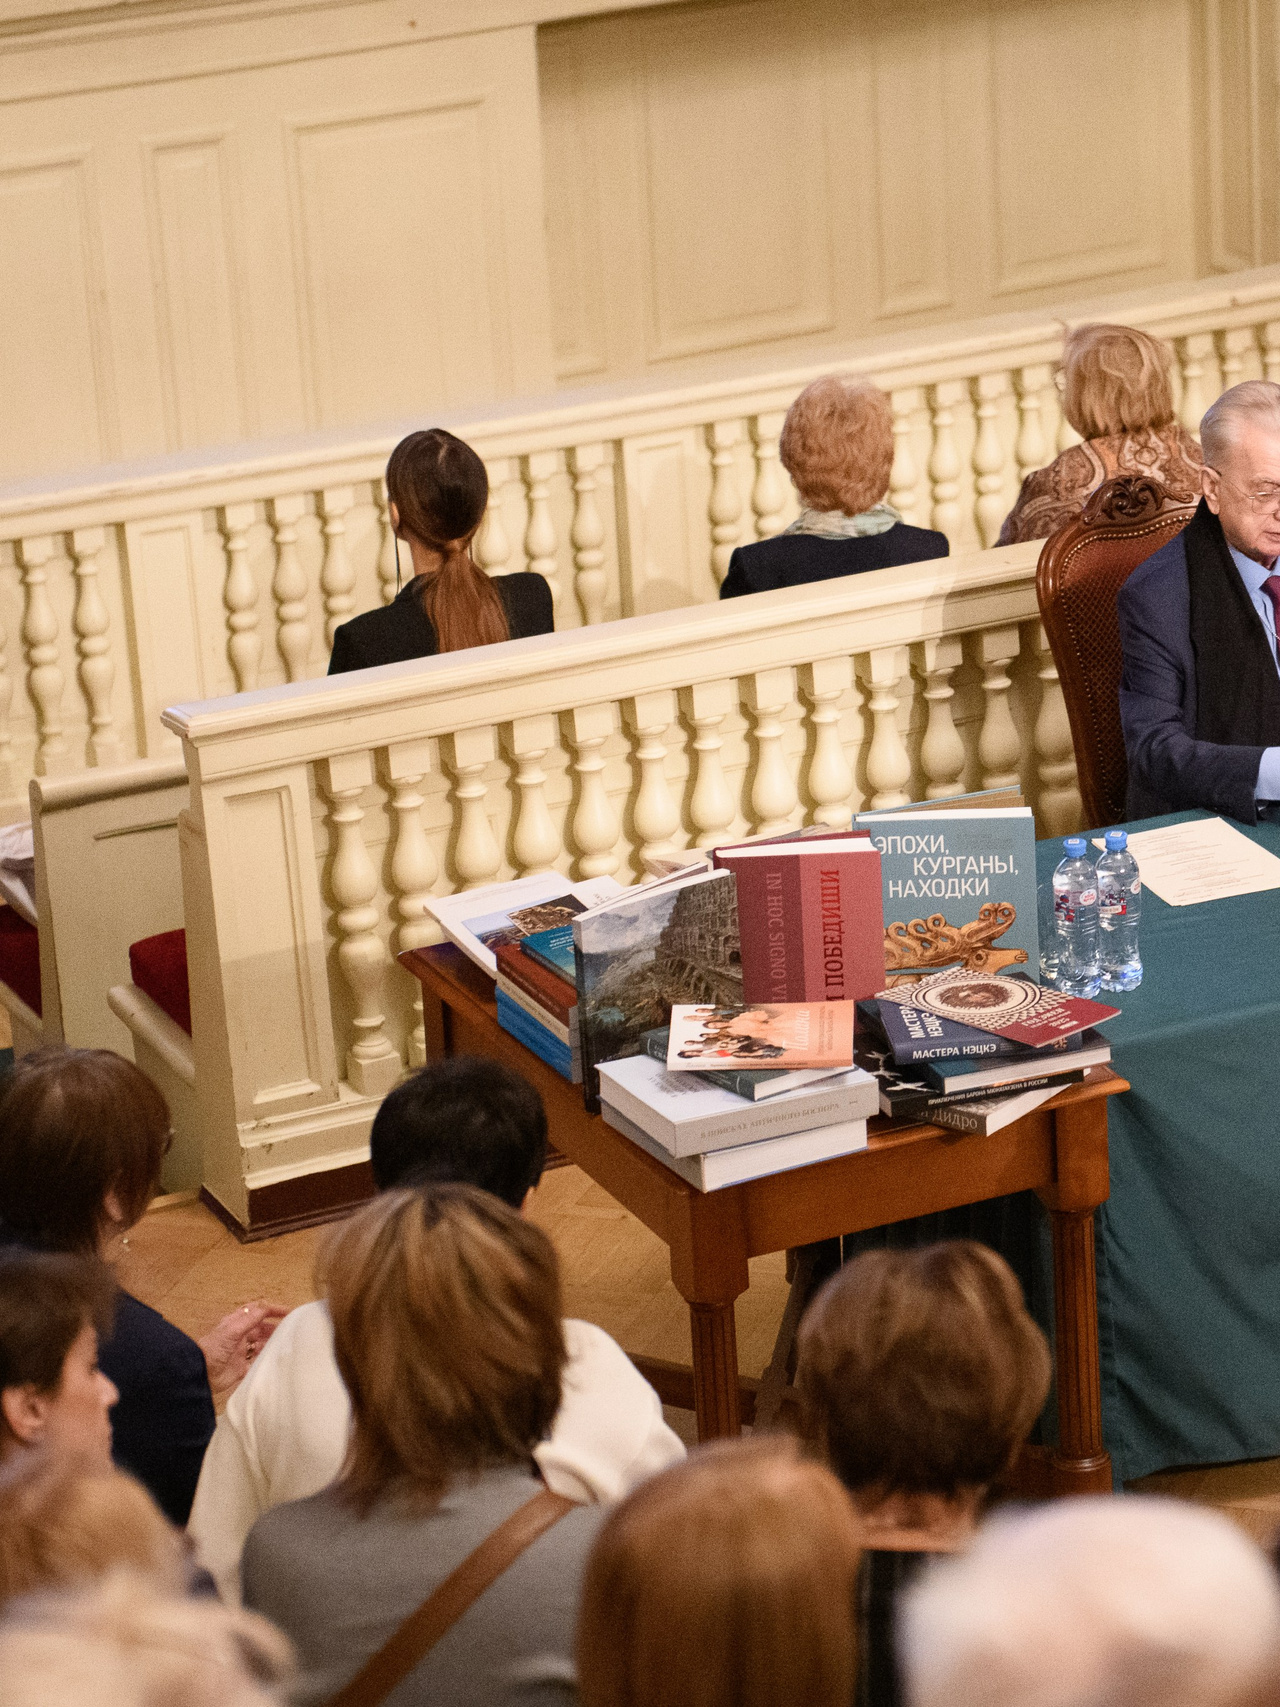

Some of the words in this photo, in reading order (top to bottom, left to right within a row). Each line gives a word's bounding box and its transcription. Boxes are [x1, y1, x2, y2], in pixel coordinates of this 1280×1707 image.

[874, 834, 949, 855] ЭПОХИ,
[913, 854, 1019, 876] КУРГАНЫ,
[766, 872, 782, 890] IN
[888, 877, 989, 900] НАХОДКИ
[767, 895, 784, 928] HOC
[820, 869, 845, 987] ПОБЕДИШИ
[768, 933, 787, 979] SIGNO
[912, 1046, 960, 1060] МАСТЕРА
[962, 1043, 997, 1056] НЭЦКЭ
[1028, 1078, 1049, 1088] РОССИИ
[932, 1107, 978, 1130] Дидро
